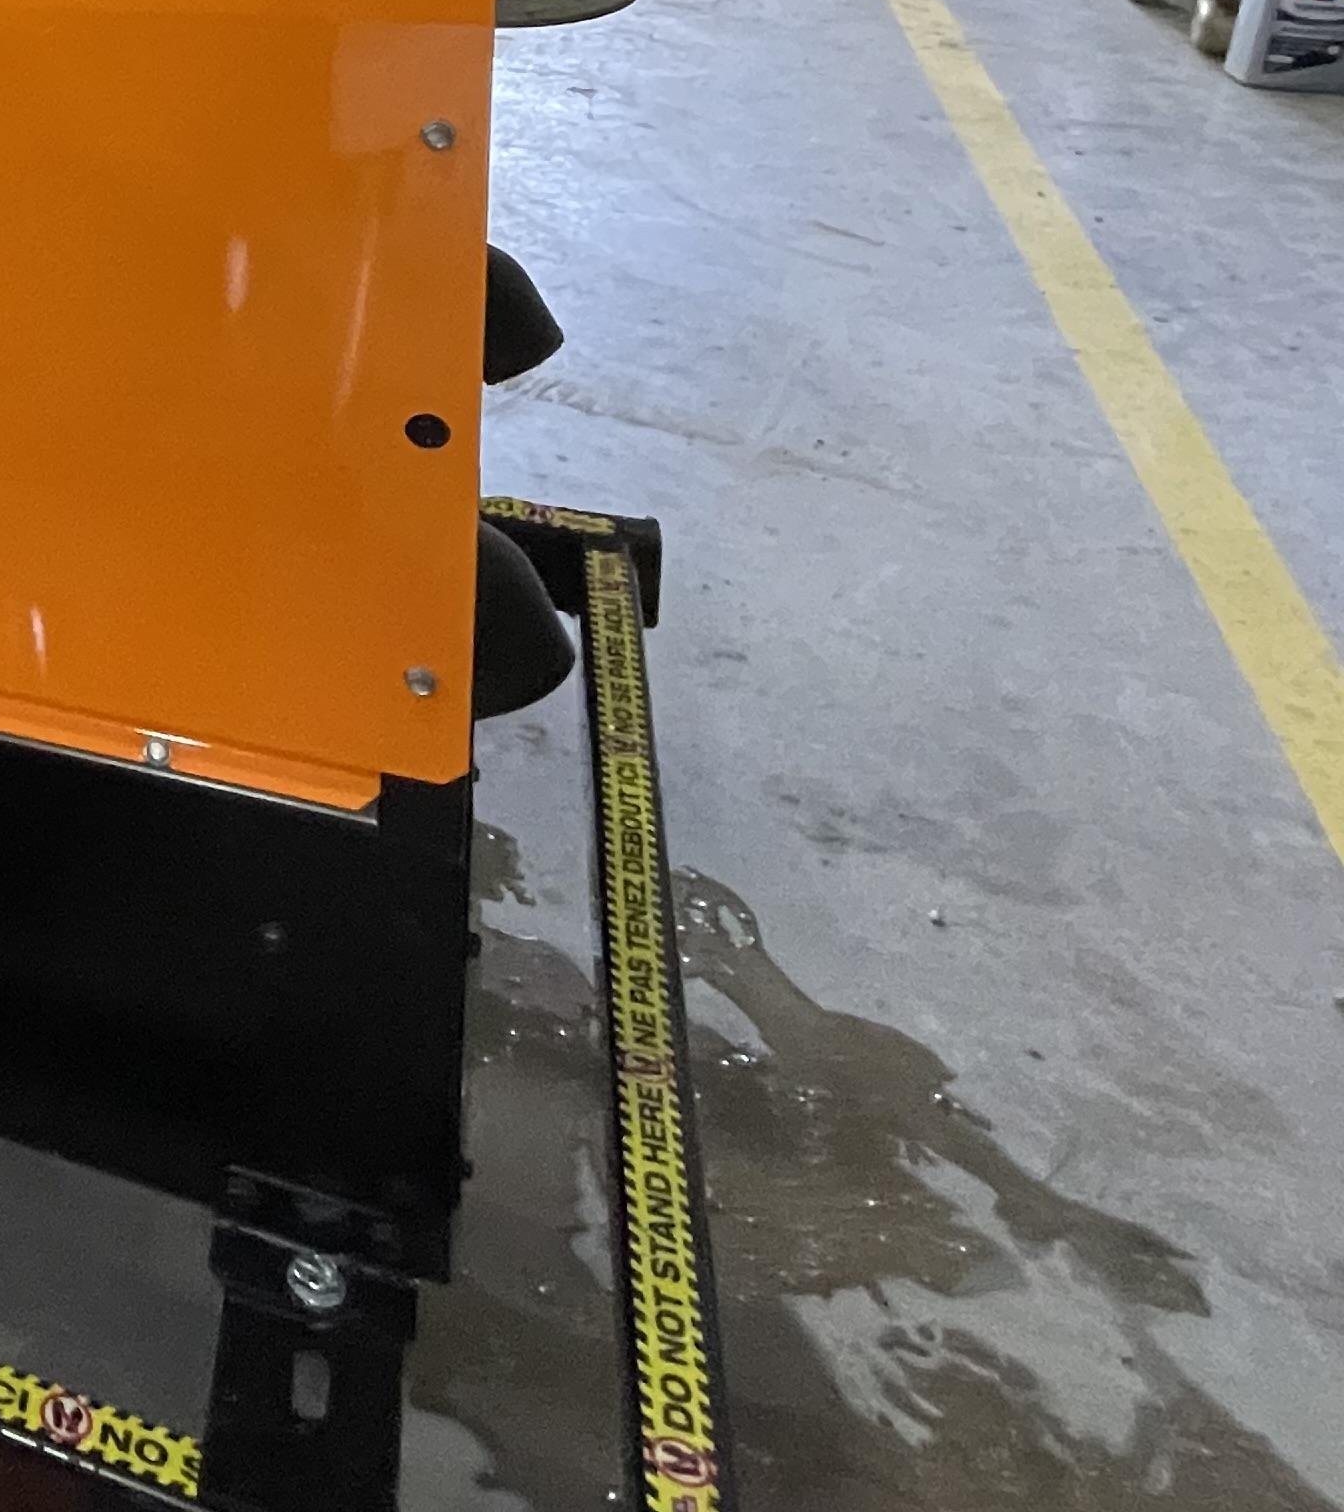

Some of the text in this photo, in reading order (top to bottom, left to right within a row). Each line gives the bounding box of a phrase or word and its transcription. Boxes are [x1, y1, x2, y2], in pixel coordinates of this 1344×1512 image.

[616, 761, 658, 1047] NE PAS TENEZ DEBOUT ICI
[636, 1082, 695, 1435] DO NOT STAND HERE
[99, 1422, 169, 1468] NO
